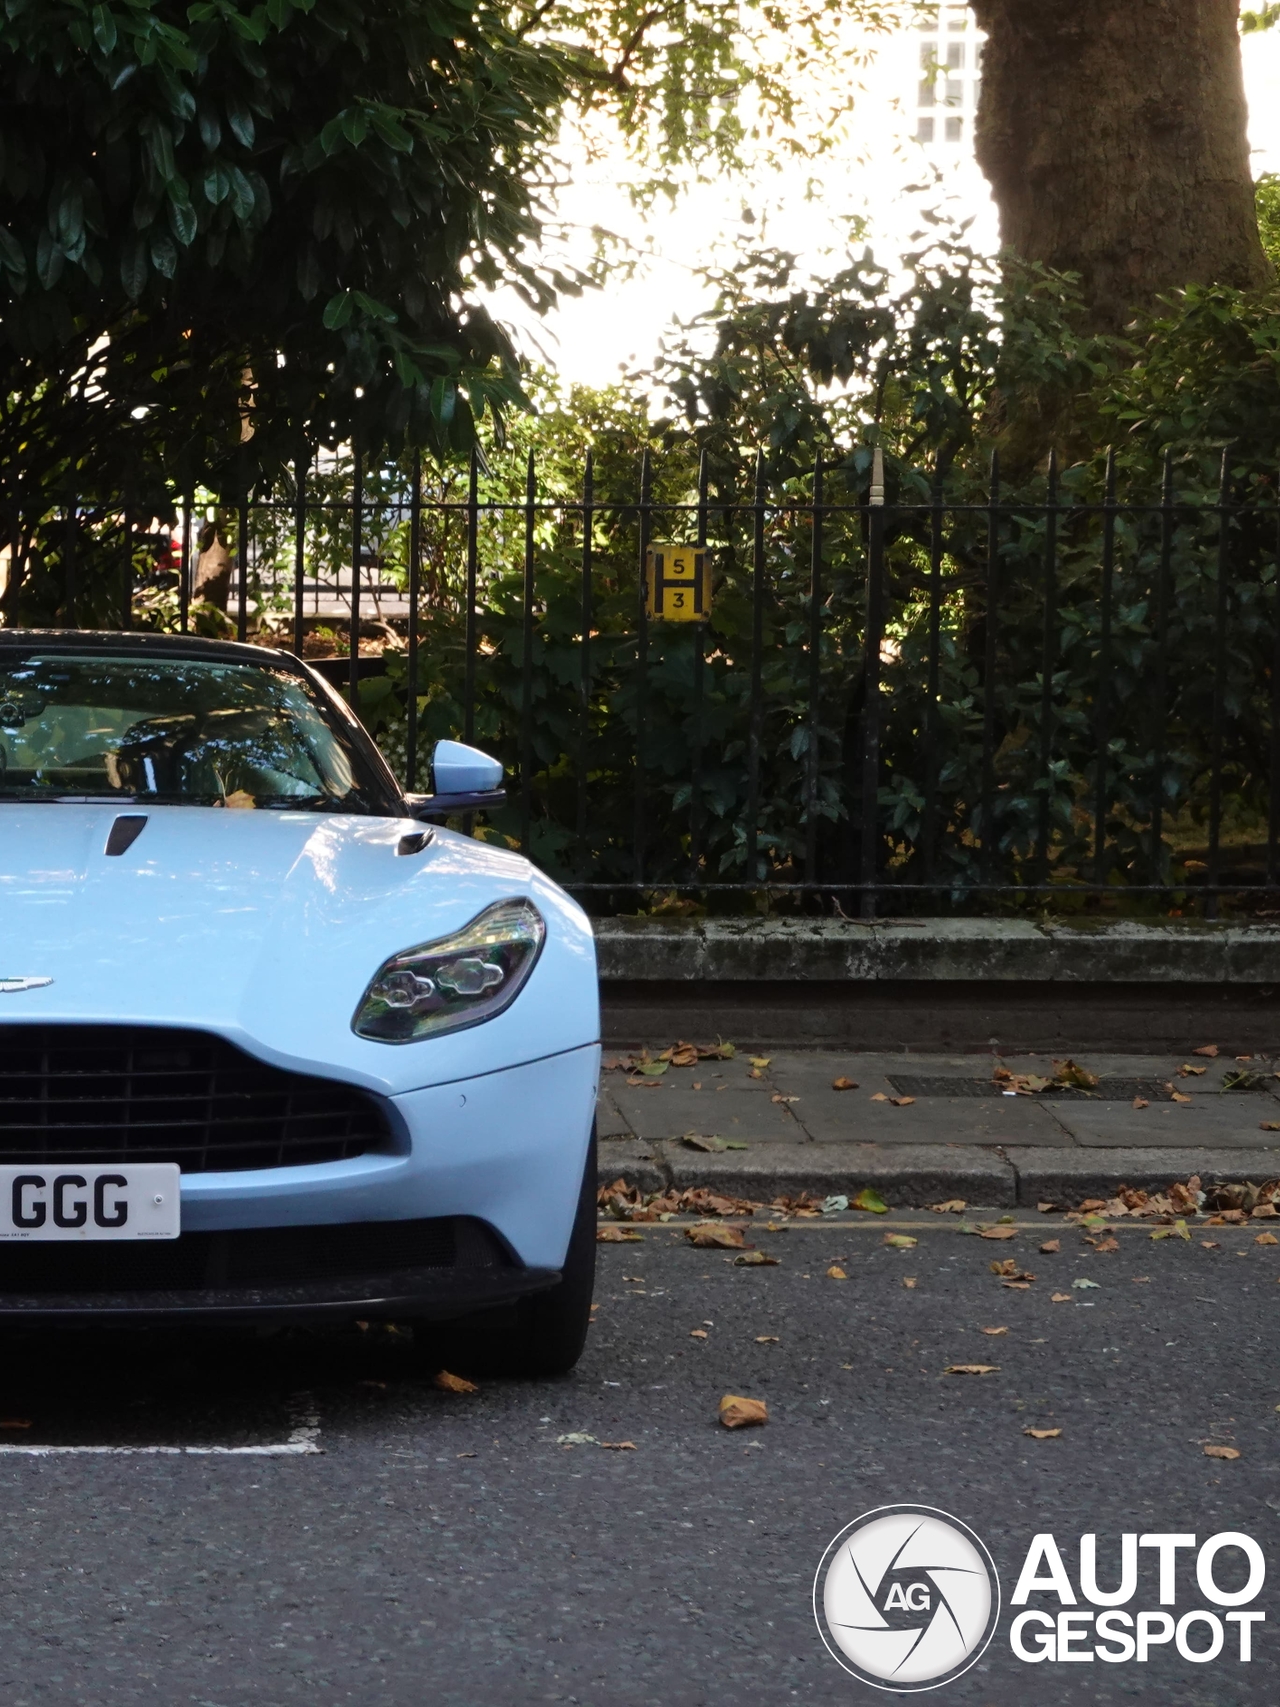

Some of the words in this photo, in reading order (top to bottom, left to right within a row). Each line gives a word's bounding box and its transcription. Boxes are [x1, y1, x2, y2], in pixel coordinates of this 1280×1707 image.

[673, 559, 685, 574] 5
[673, 593, 684, 608] 3
[11, 1174, 129, 1228] GGG
